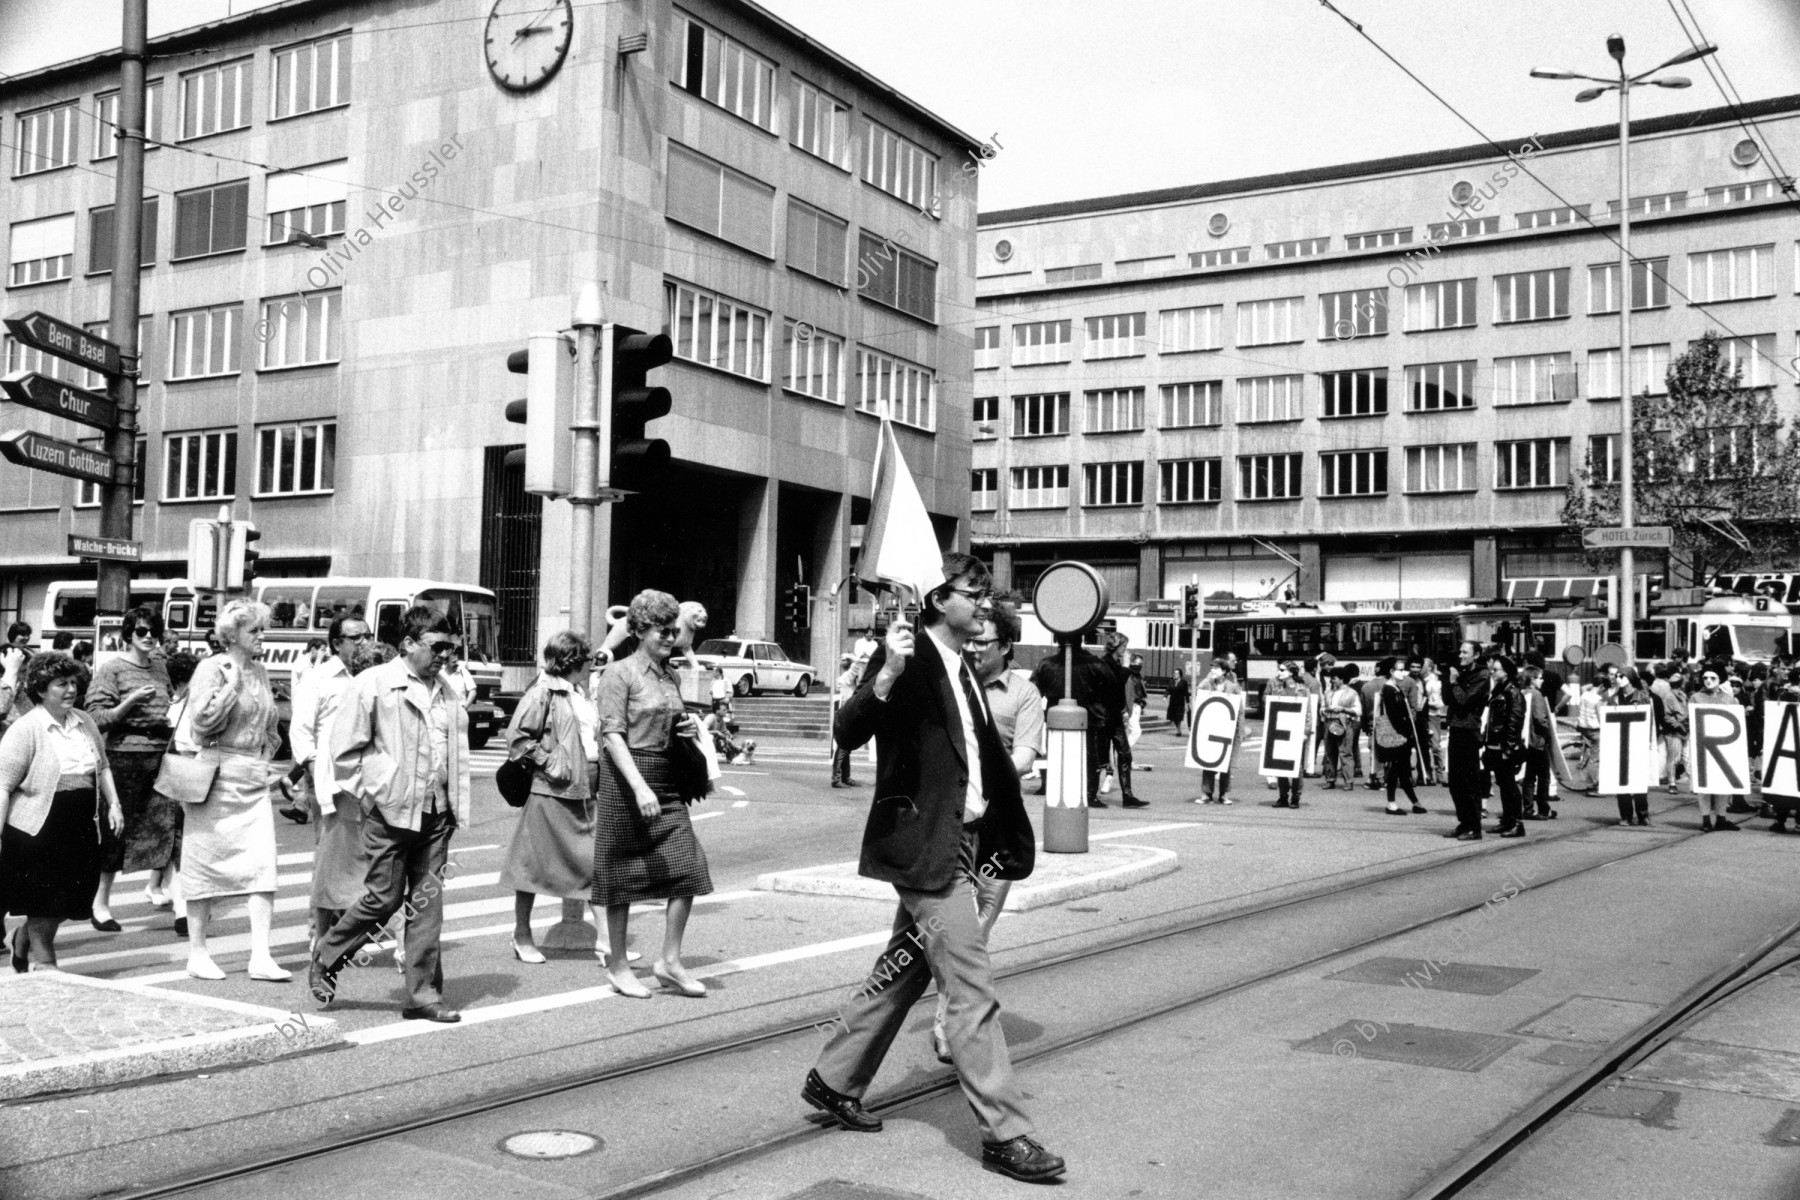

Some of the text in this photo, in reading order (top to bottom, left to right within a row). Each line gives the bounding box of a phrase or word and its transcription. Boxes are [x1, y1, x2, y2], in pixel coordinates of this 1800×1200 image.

[49, 323, 106, 364] Bern Basel
[59, 388, 90, 415] Chur
[30, 437, 110, 478] Luzern Gotthard
[1601, 531, 1629, 541] HOTEL
[73, 539, 138, 556] Walche-Brücke
[1758, 600, 1766, 610] 7
